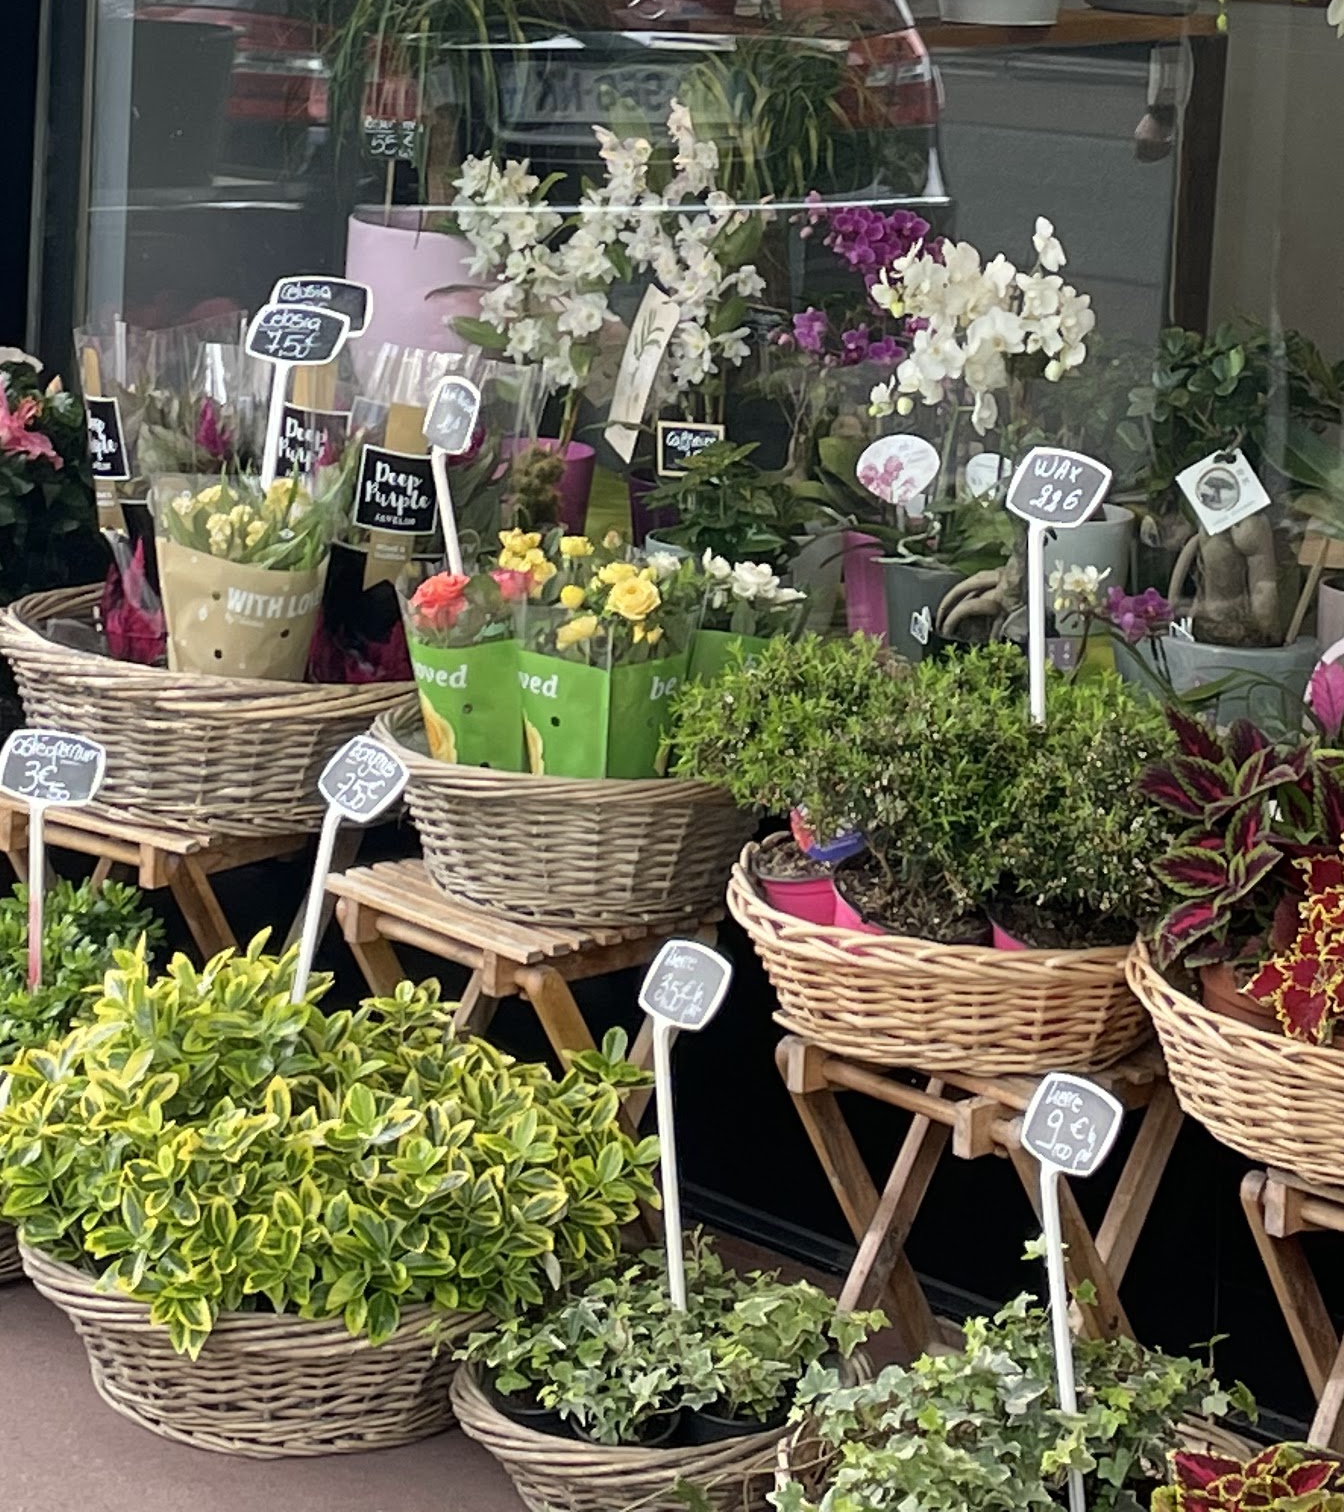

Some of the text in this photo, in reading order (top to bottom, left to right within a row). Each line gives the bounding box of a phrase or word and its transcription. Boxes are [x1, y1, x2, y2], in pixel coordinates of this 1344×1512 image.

[375, 461, 423, 496] Deep
[1034, 456, 1084, 483] WAX
[364, 480, 431, 516] Purple
[227, 586, 286, 619] WITH
